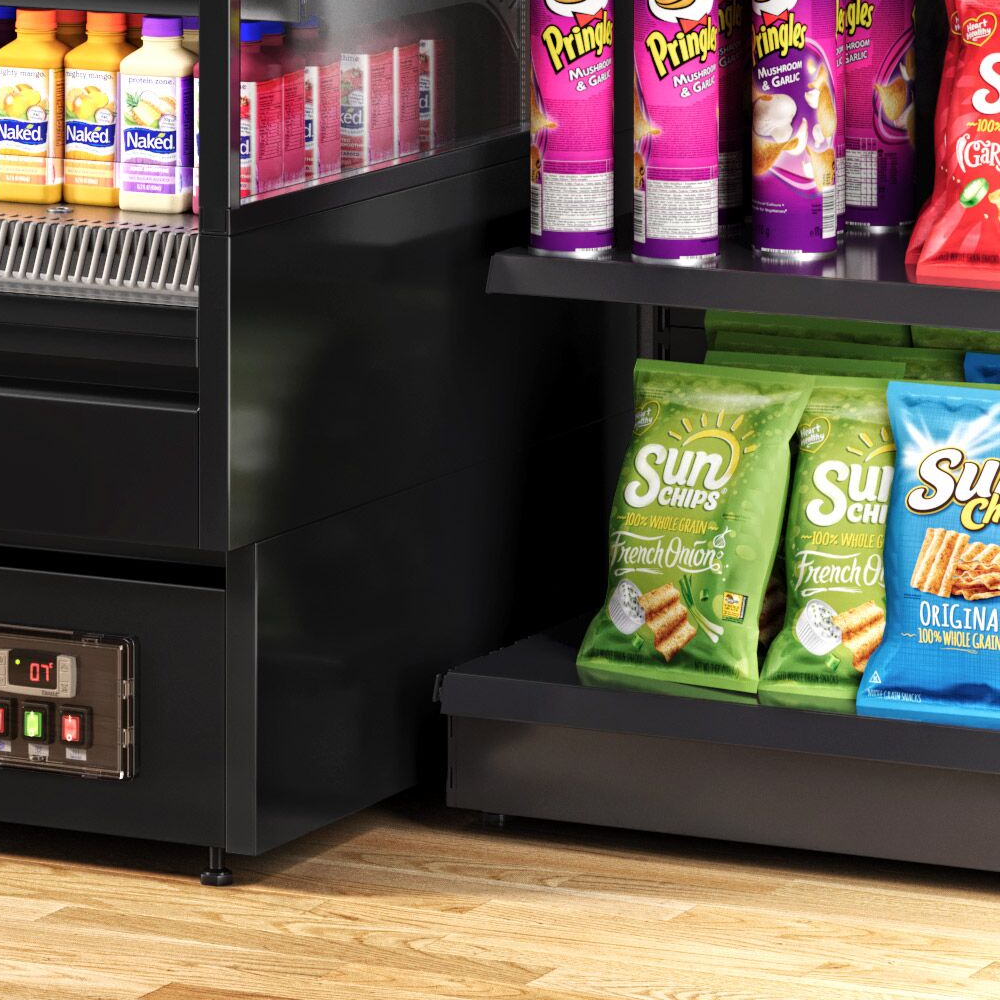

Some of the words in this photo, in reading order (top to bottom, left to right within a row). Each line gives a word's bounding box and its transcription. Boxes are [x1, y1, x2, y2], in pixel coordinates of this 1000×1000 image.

[966, 18, 988, 31] Heart
[966, 26, 992, 41] Healthy
[543, 11, 613, 73] Pringles
[646, 16, 718, 79] Pringles
[20, 70, 45, 79] mango
[88, 73, 113, 81] mango
[128, 77, 153, 85] protein
[762, 80, 770, 91] &
[771, 72, 800, 87] GARLIC
[576, 81, 587, 92] &
[680, 87, 691, 98] &
[66, 124, 109, 144] Naked
[127, 131, 173, 150] Naked
[624, 443, 733, 509] Sun
[658, 488, 720, 511] CHIPS
[626, 512, 648, 527] 100%
[650, 515, 677, 532] WHOLE
[679, 518, 708, 535] GRAIN
[812, 530, 839, 546] 100%
[841, 533, 873, 549] WHOLE
[610, 531, 665, 568] French
[665, 536, 717, 570] Onion
[794, 549, 861, 590] French
[919, 600, 1000, 630] ORIGINA
[917, 626, 942, 644] 100%
[943, 630, 970, 648] WHOLE
[972, 633, 1000, 651] GRAIN
